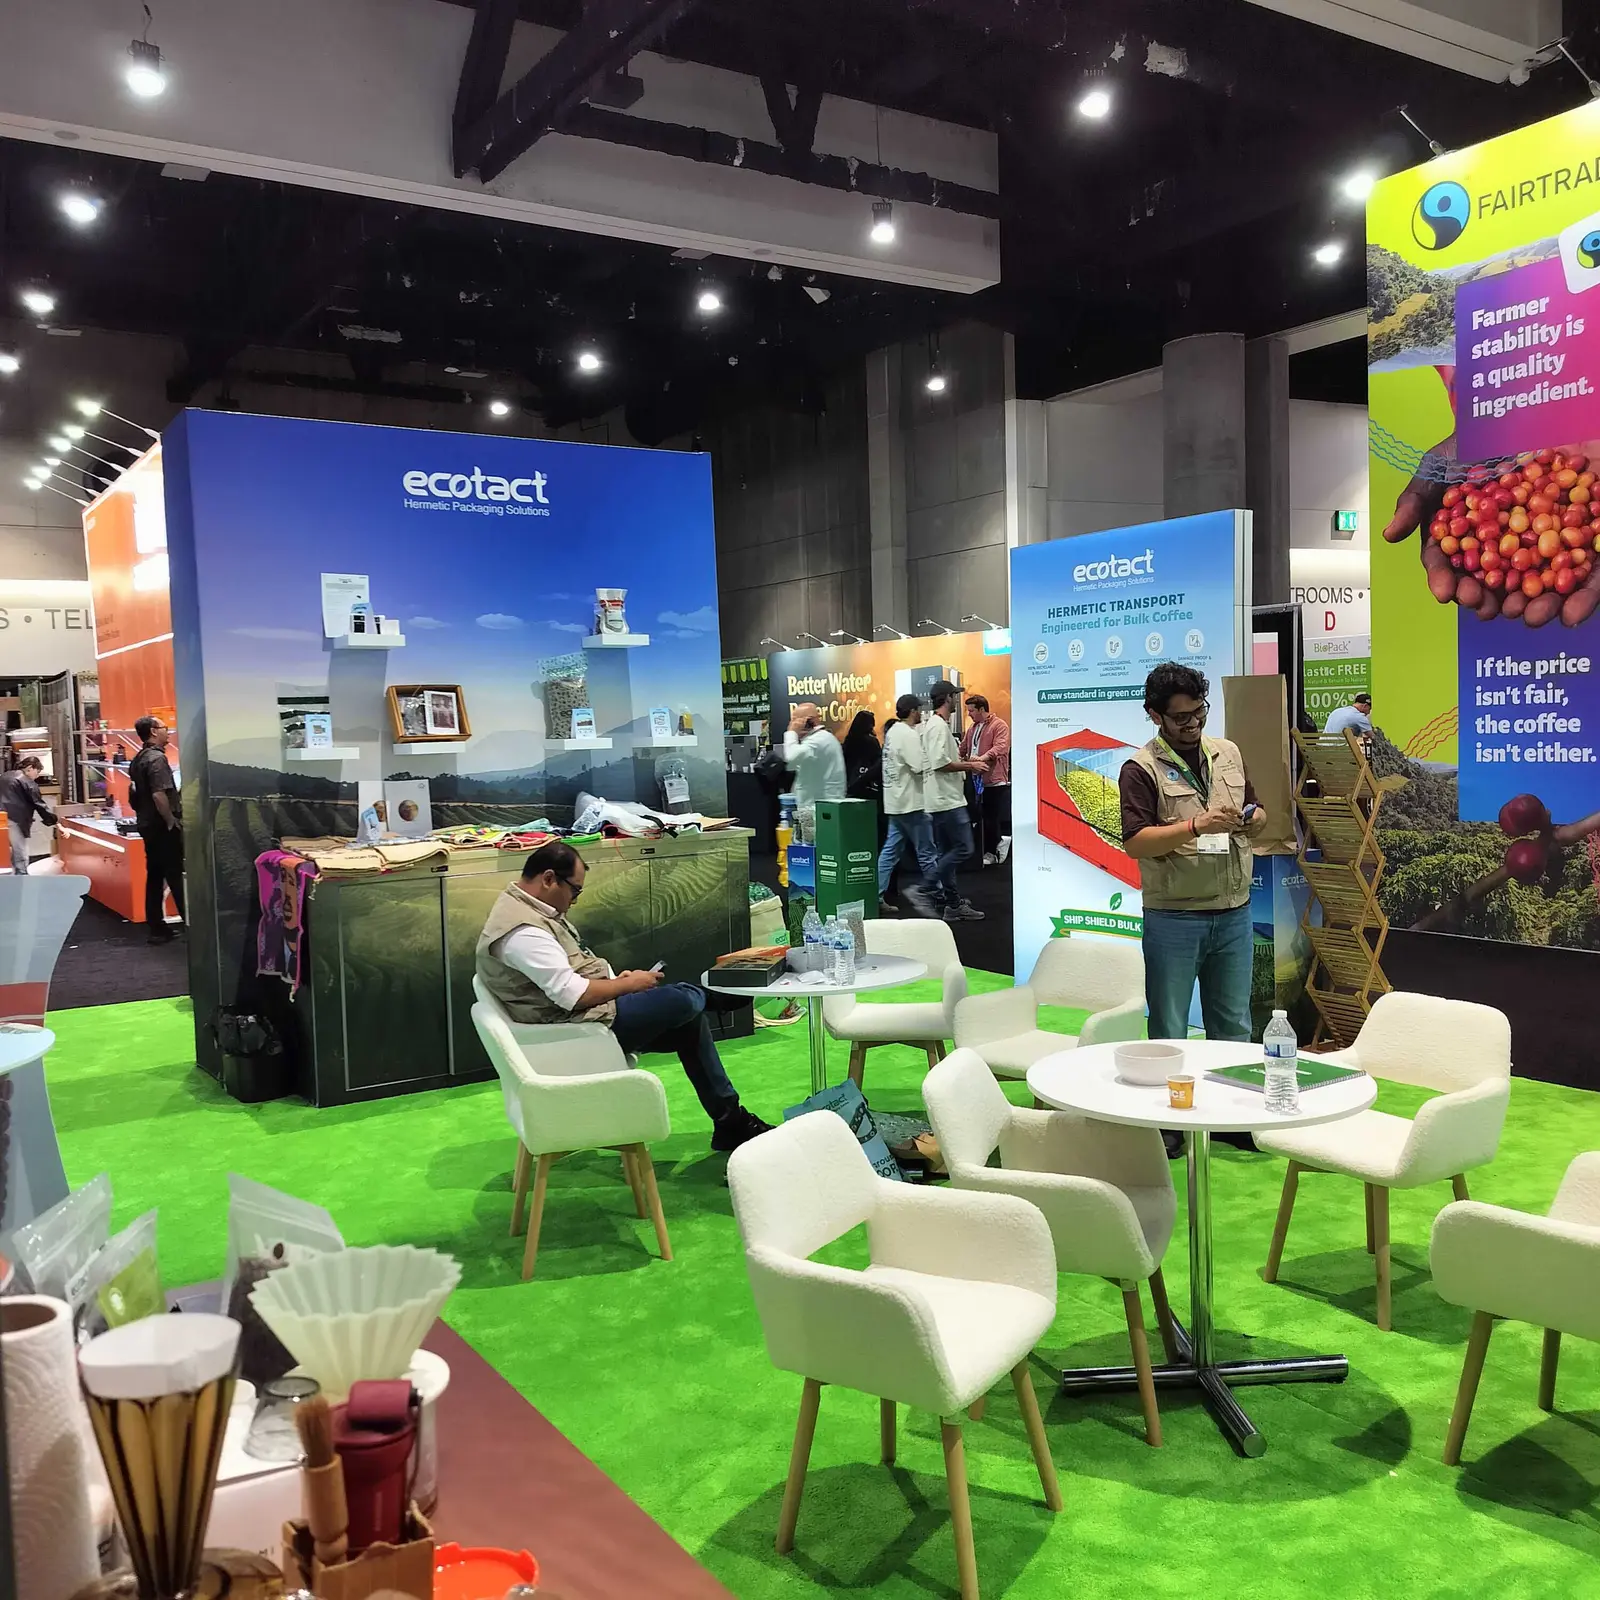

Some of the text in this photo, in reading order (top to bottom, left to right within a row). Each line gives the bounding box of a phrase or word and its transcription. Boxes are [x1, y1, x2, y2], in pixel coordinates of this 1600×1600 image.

[1472, 296, 1550, 331] Farmer
[1471, 314, 1585, 360] stability is
[1471, 351, 1565, 390] a quality
[1472, 375, 1595, 419] ingredient.
[402, 465, 550, 504] ecotact
[403, 498, 550, 517] Hermetic Packaging Solutions
[1073, 548, 1155, 583] ecotact
[1073, 576, 1155, 592] Hermetic Packaging Solutions
[1048, 593, 1185, 619] HERMETIC TRANSPORT
[1041, 609, 1193, 635] Engineered for Bulk Coffee
[1325, 611, 1336, 631] D
[1338, 663, 1367, 676] FREE
[1476, 652, 1591, 680] If the price
[787, 672, 872, 696] Better Water
[1041, 687, 1147, 700] A new standard in green cof
[1475, 682, 1569, 707] isn't fair,
[1475, 712, 1581, 734] the coffee
[1475, 741, 1597, 763] isn't either.
[1063, 915, 1142, 932] SHIP SHIELD BULK
